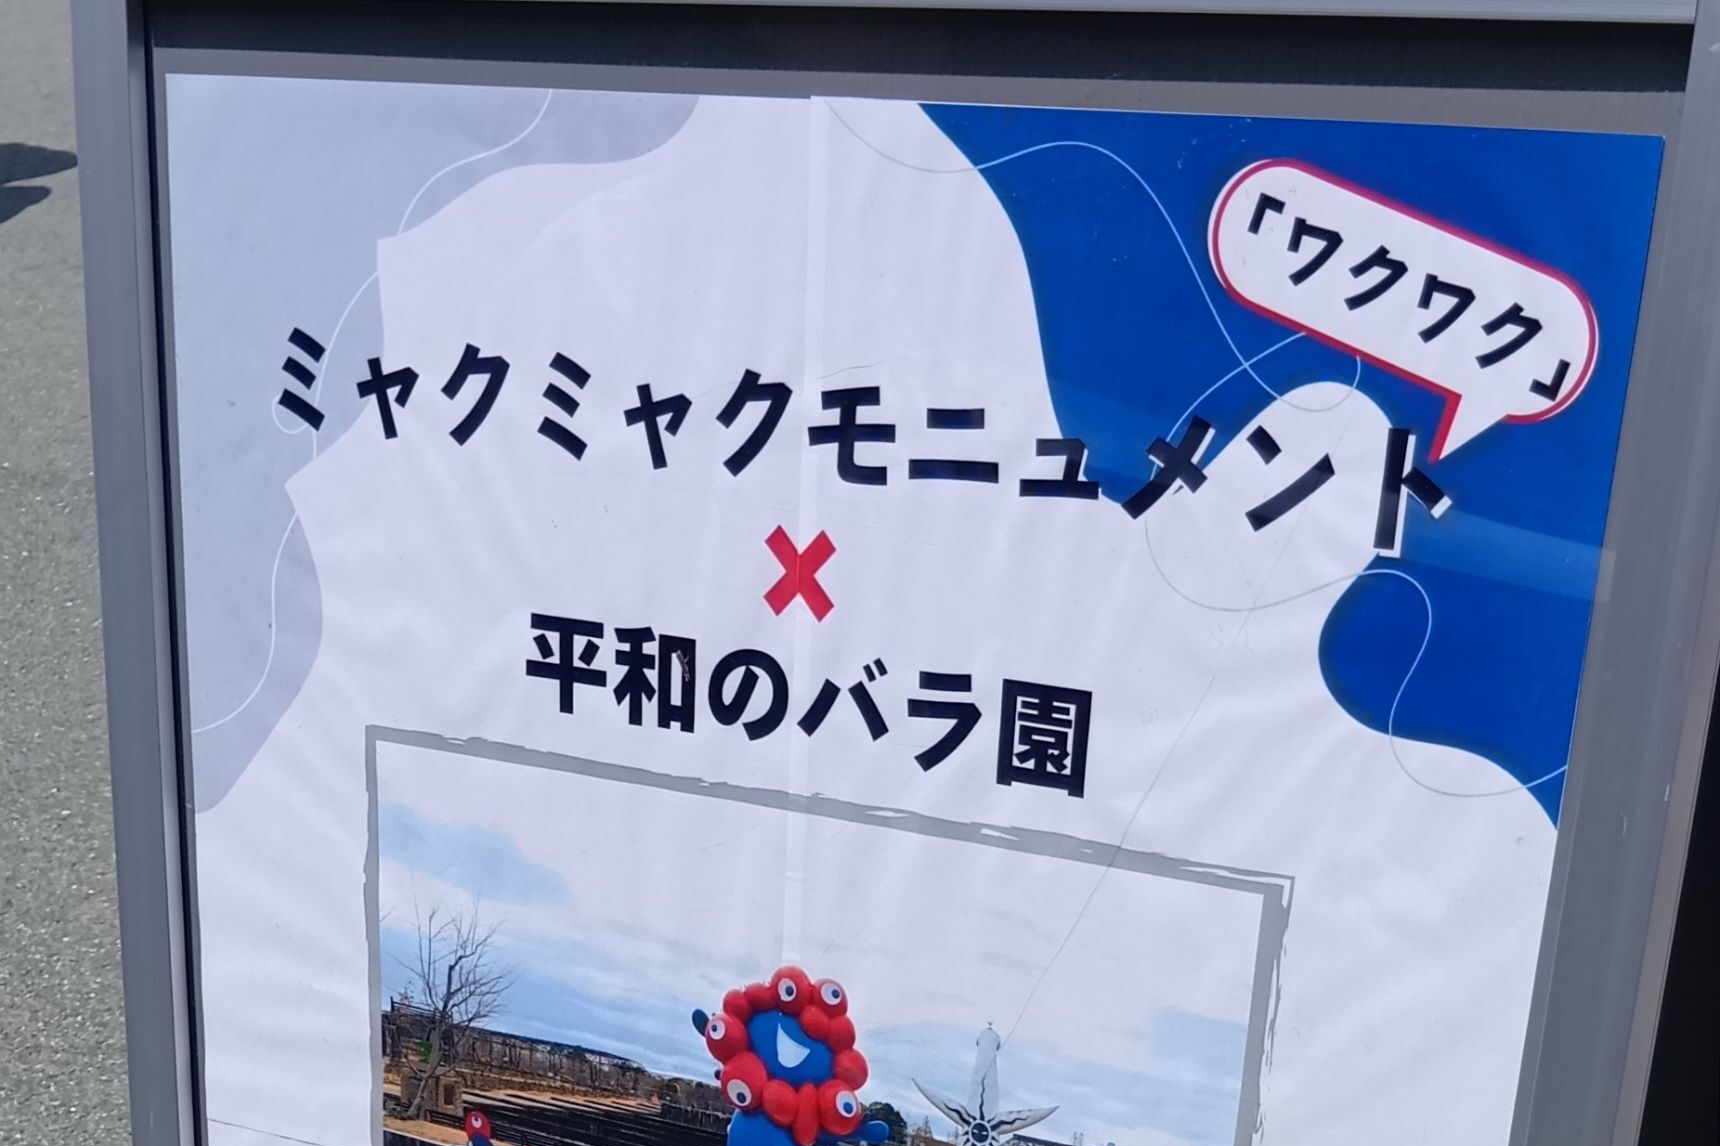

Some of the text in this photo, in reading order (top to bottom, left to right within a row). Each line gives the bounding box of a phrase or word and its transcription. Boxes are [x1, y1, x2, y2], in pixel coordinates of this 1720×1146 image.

[1247, 192, 1571, 402] 「ワクワク」
[278, 326, 1452, 555] ミャクミャクモニュメント
[525, 612, 1093, 798] 平和のバラ園
